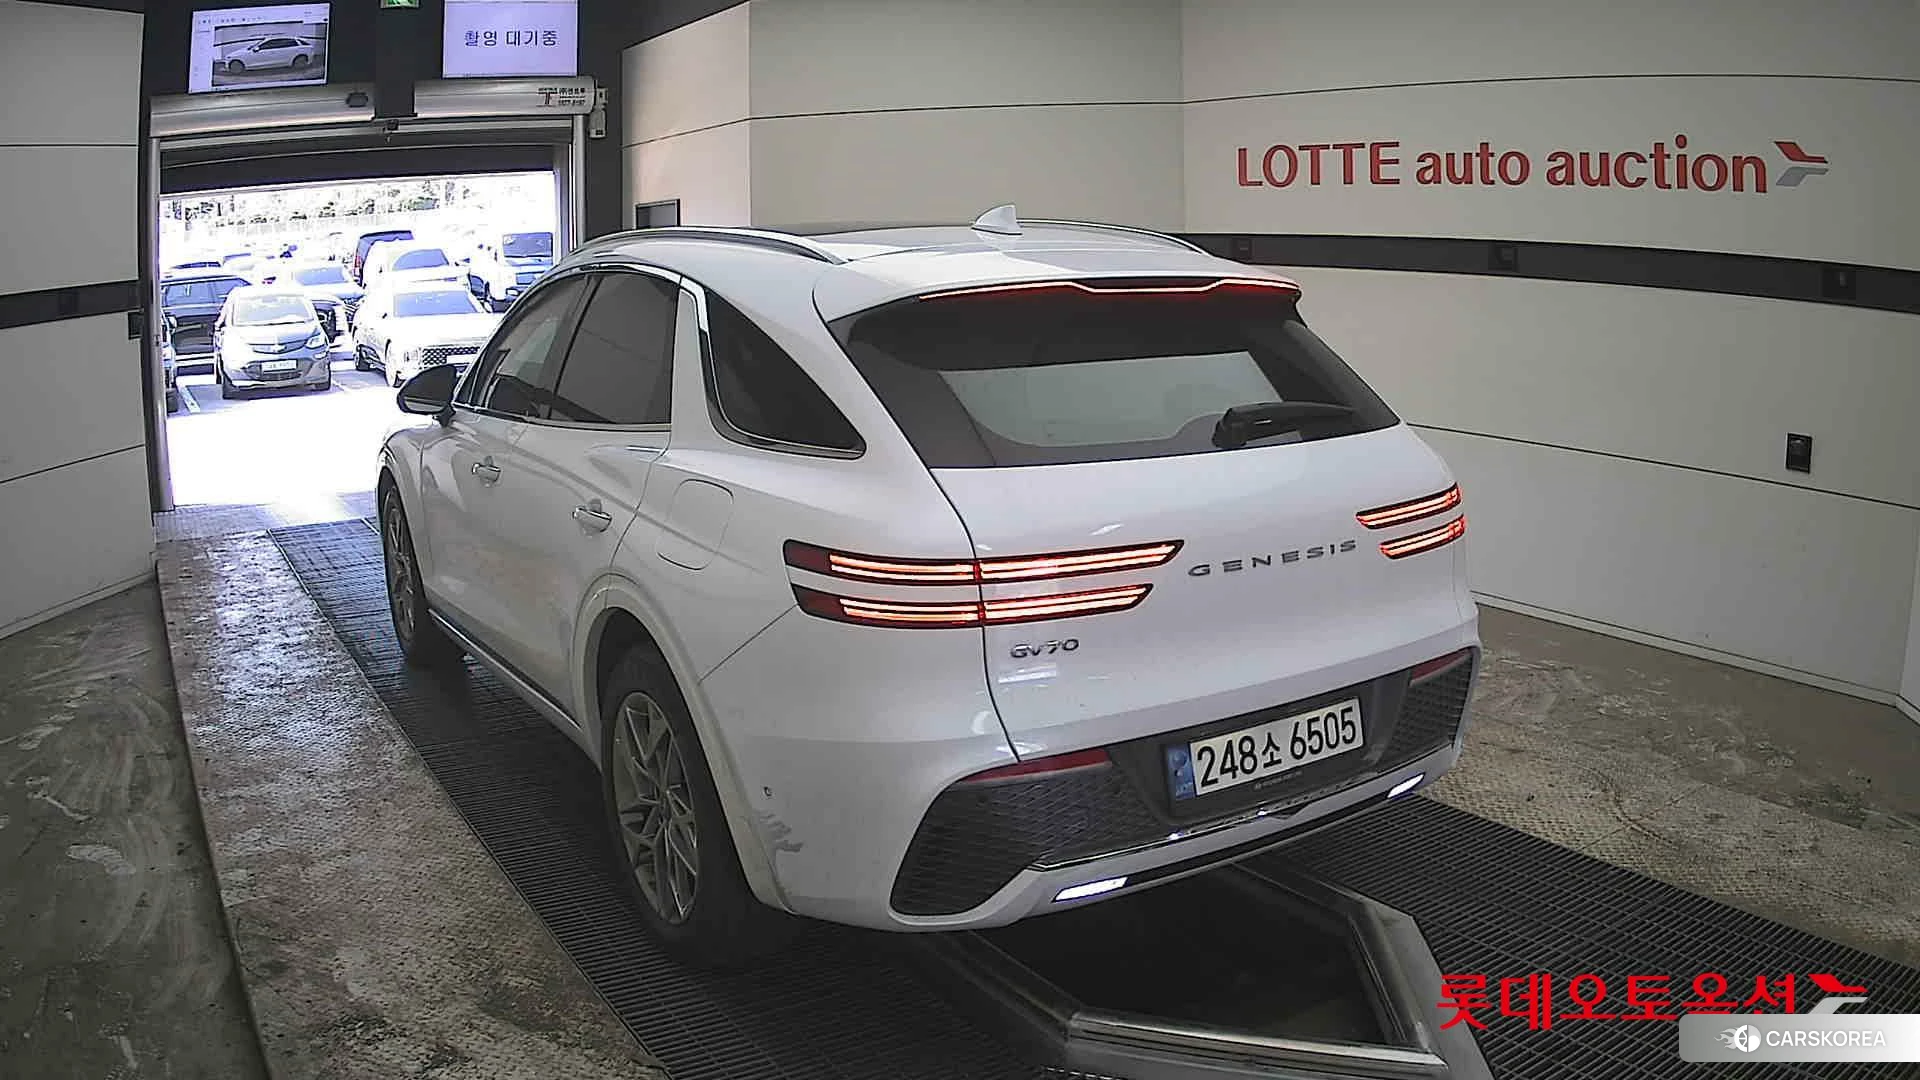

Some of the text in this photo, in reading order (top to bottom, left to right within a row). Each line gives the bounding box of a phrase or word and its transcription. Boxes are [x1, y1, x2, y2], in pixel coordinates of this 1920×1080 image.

[506, 30, 557, 47] 대기중
[1237, 134, 1767, 193] LOTTE auto auction
[1187, 539, 1357, 577] GENESIS
[1010, 638, 1079, 659] GV70
[1290, 706, 1357, 761] 6505
